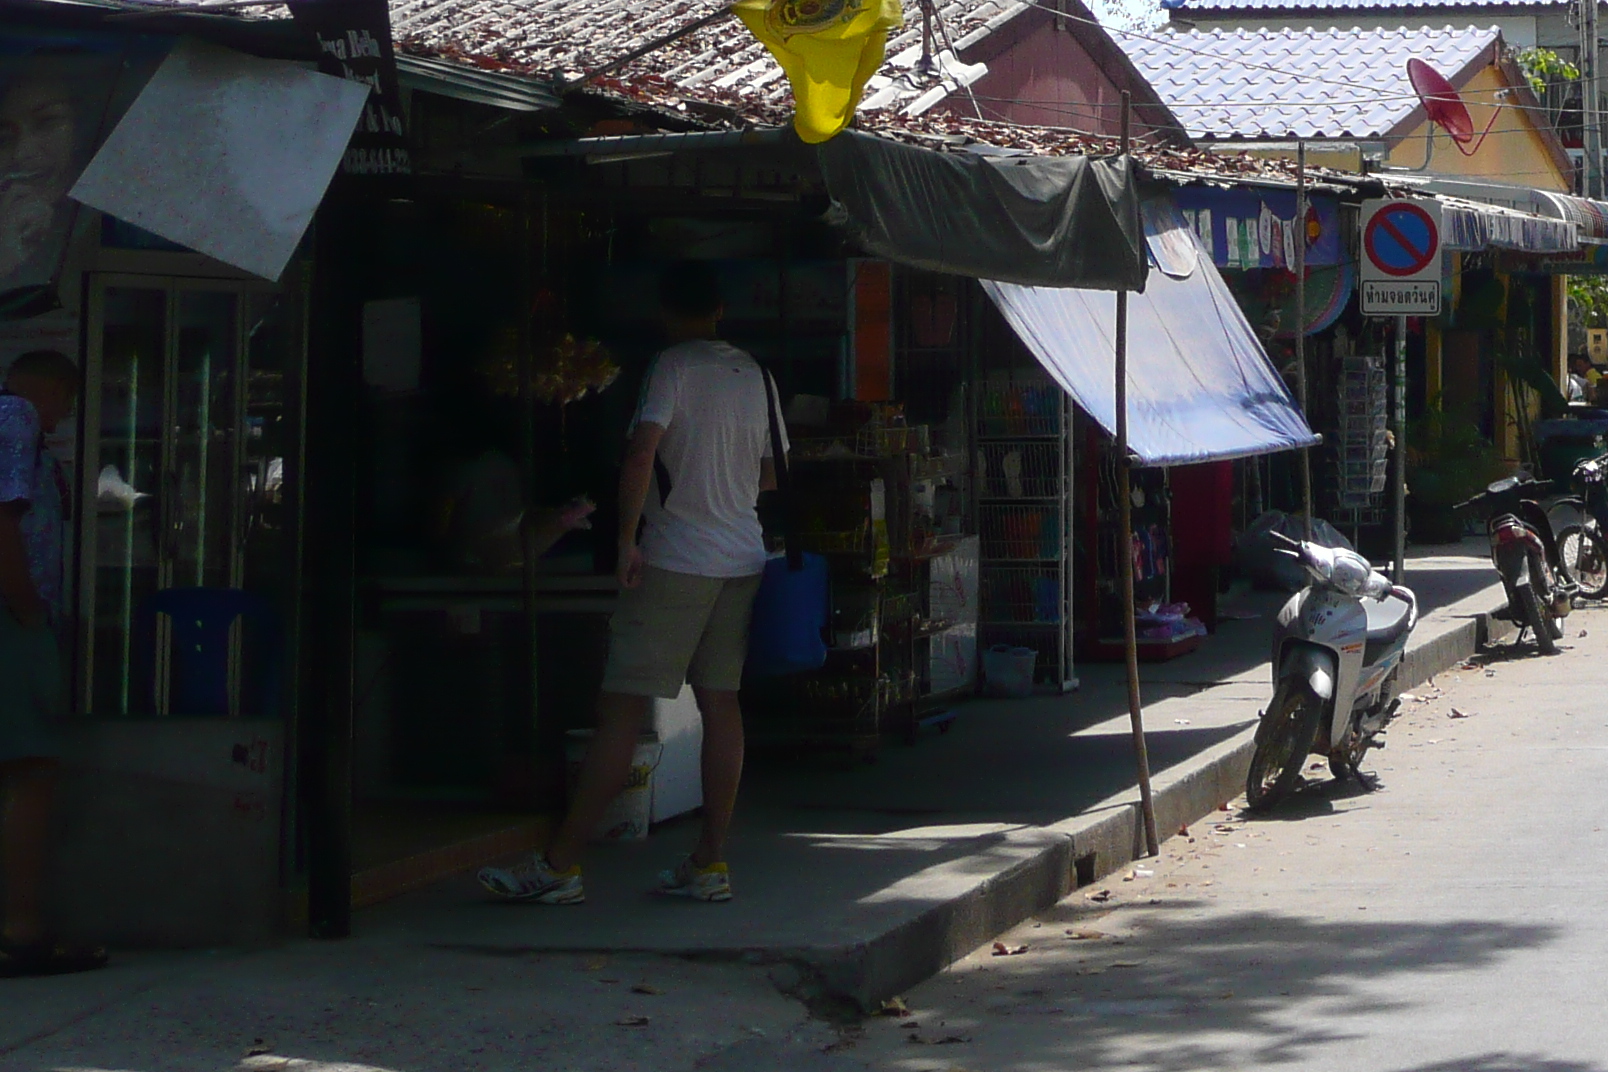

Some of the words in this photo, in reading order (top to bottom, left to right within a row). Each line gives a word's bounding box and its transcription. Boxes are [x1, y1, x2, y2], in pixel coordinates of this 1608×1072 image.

[1366, 285, 1436, 310] ห้ามจอดวันคู่
